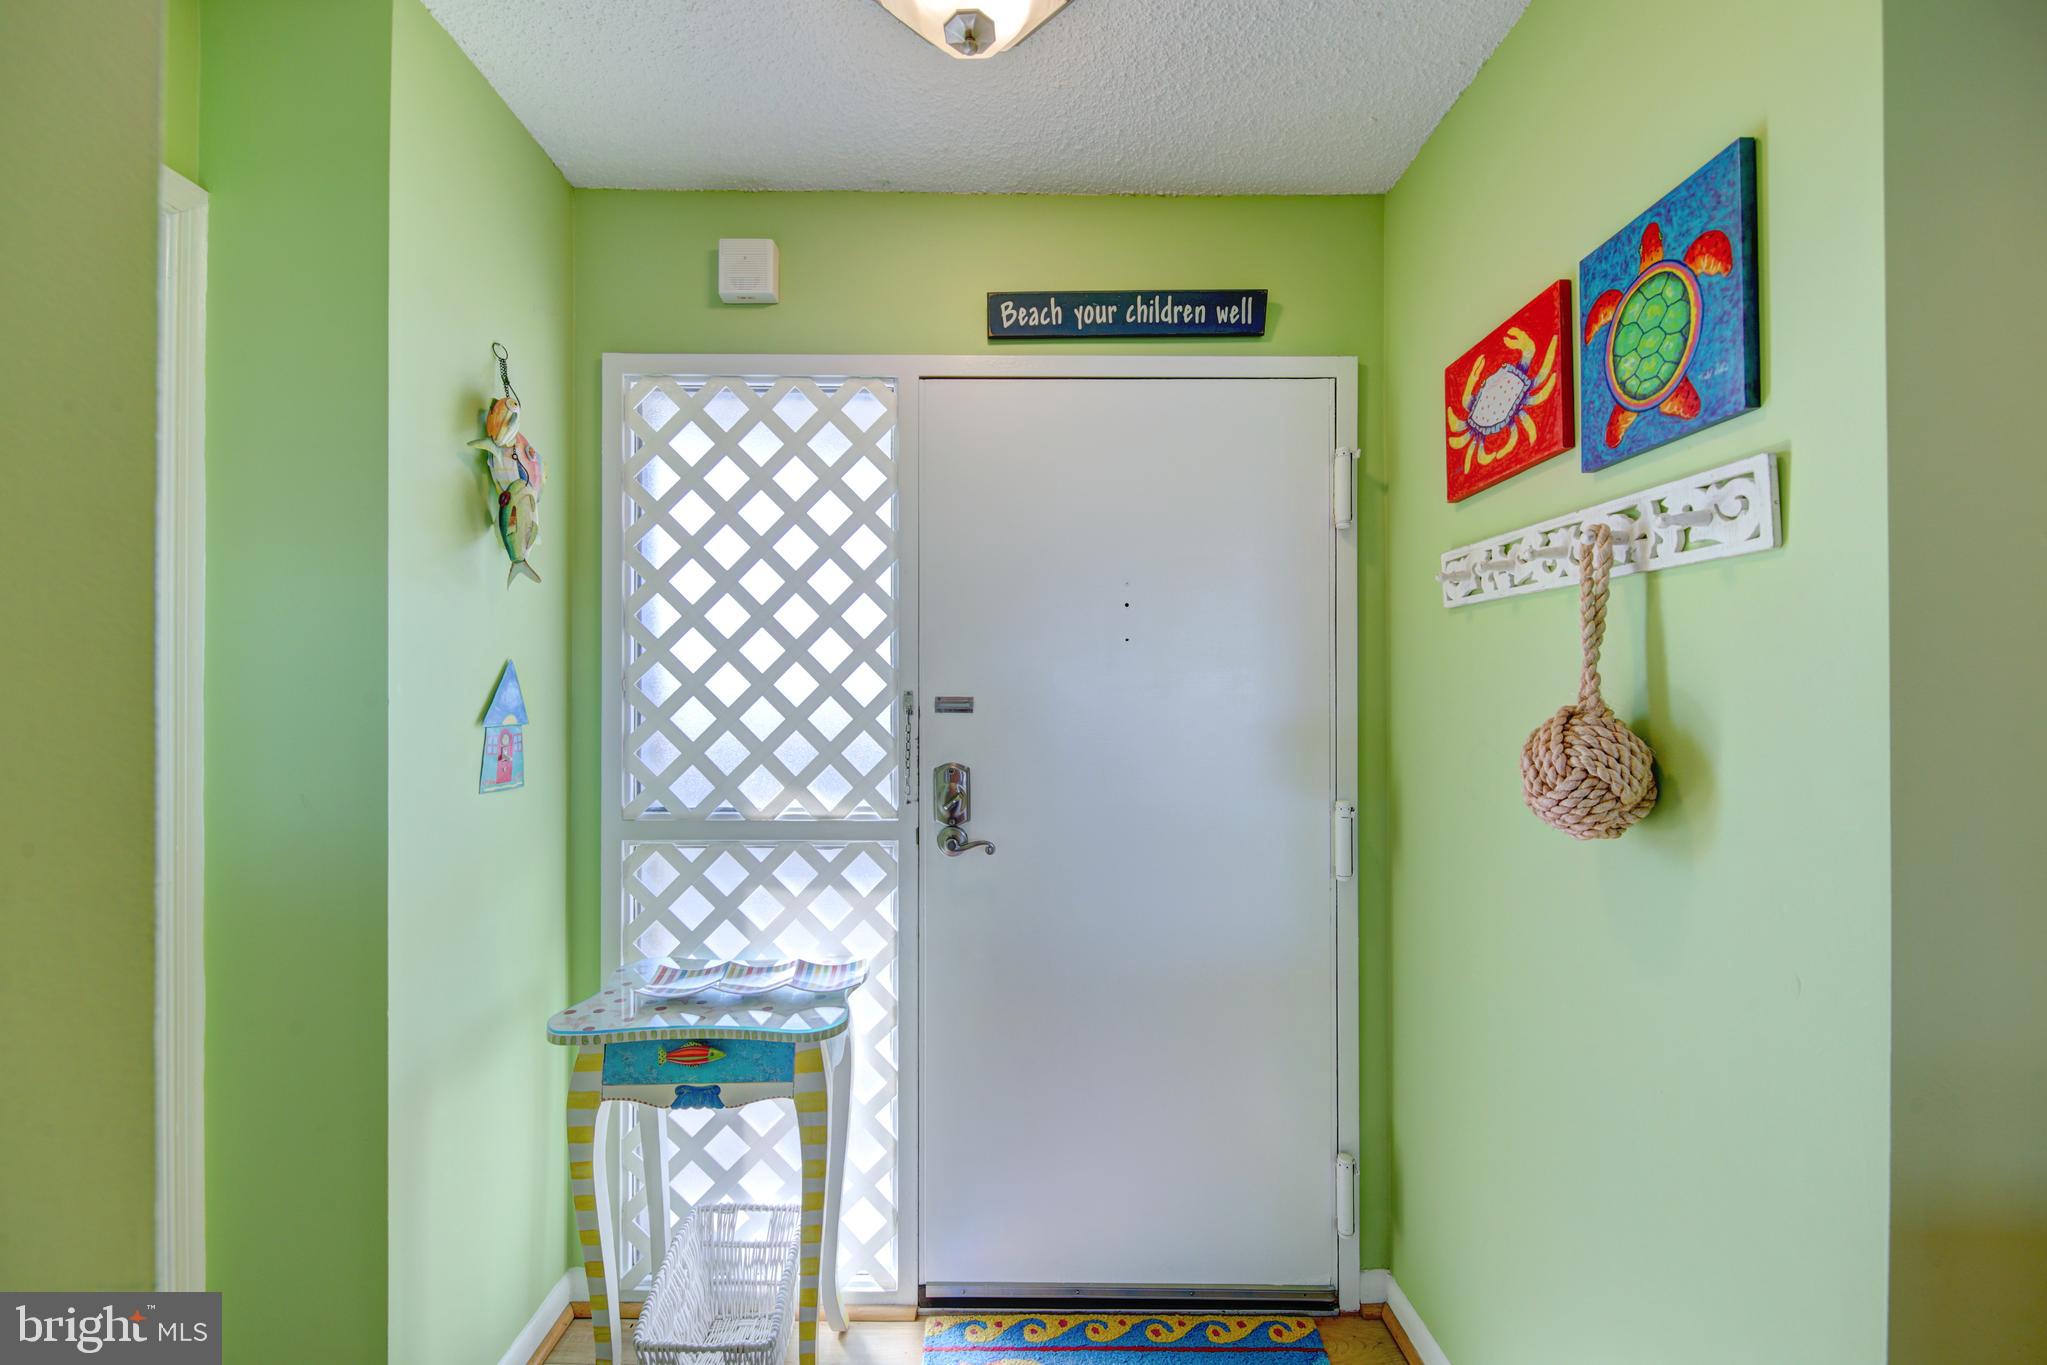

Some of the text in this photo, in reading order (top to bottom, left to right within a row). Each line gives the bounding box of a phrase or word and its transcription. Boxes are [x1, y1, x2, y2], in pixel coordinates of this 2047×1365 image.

[1000, 295, 1252, 330] Beach your children well
